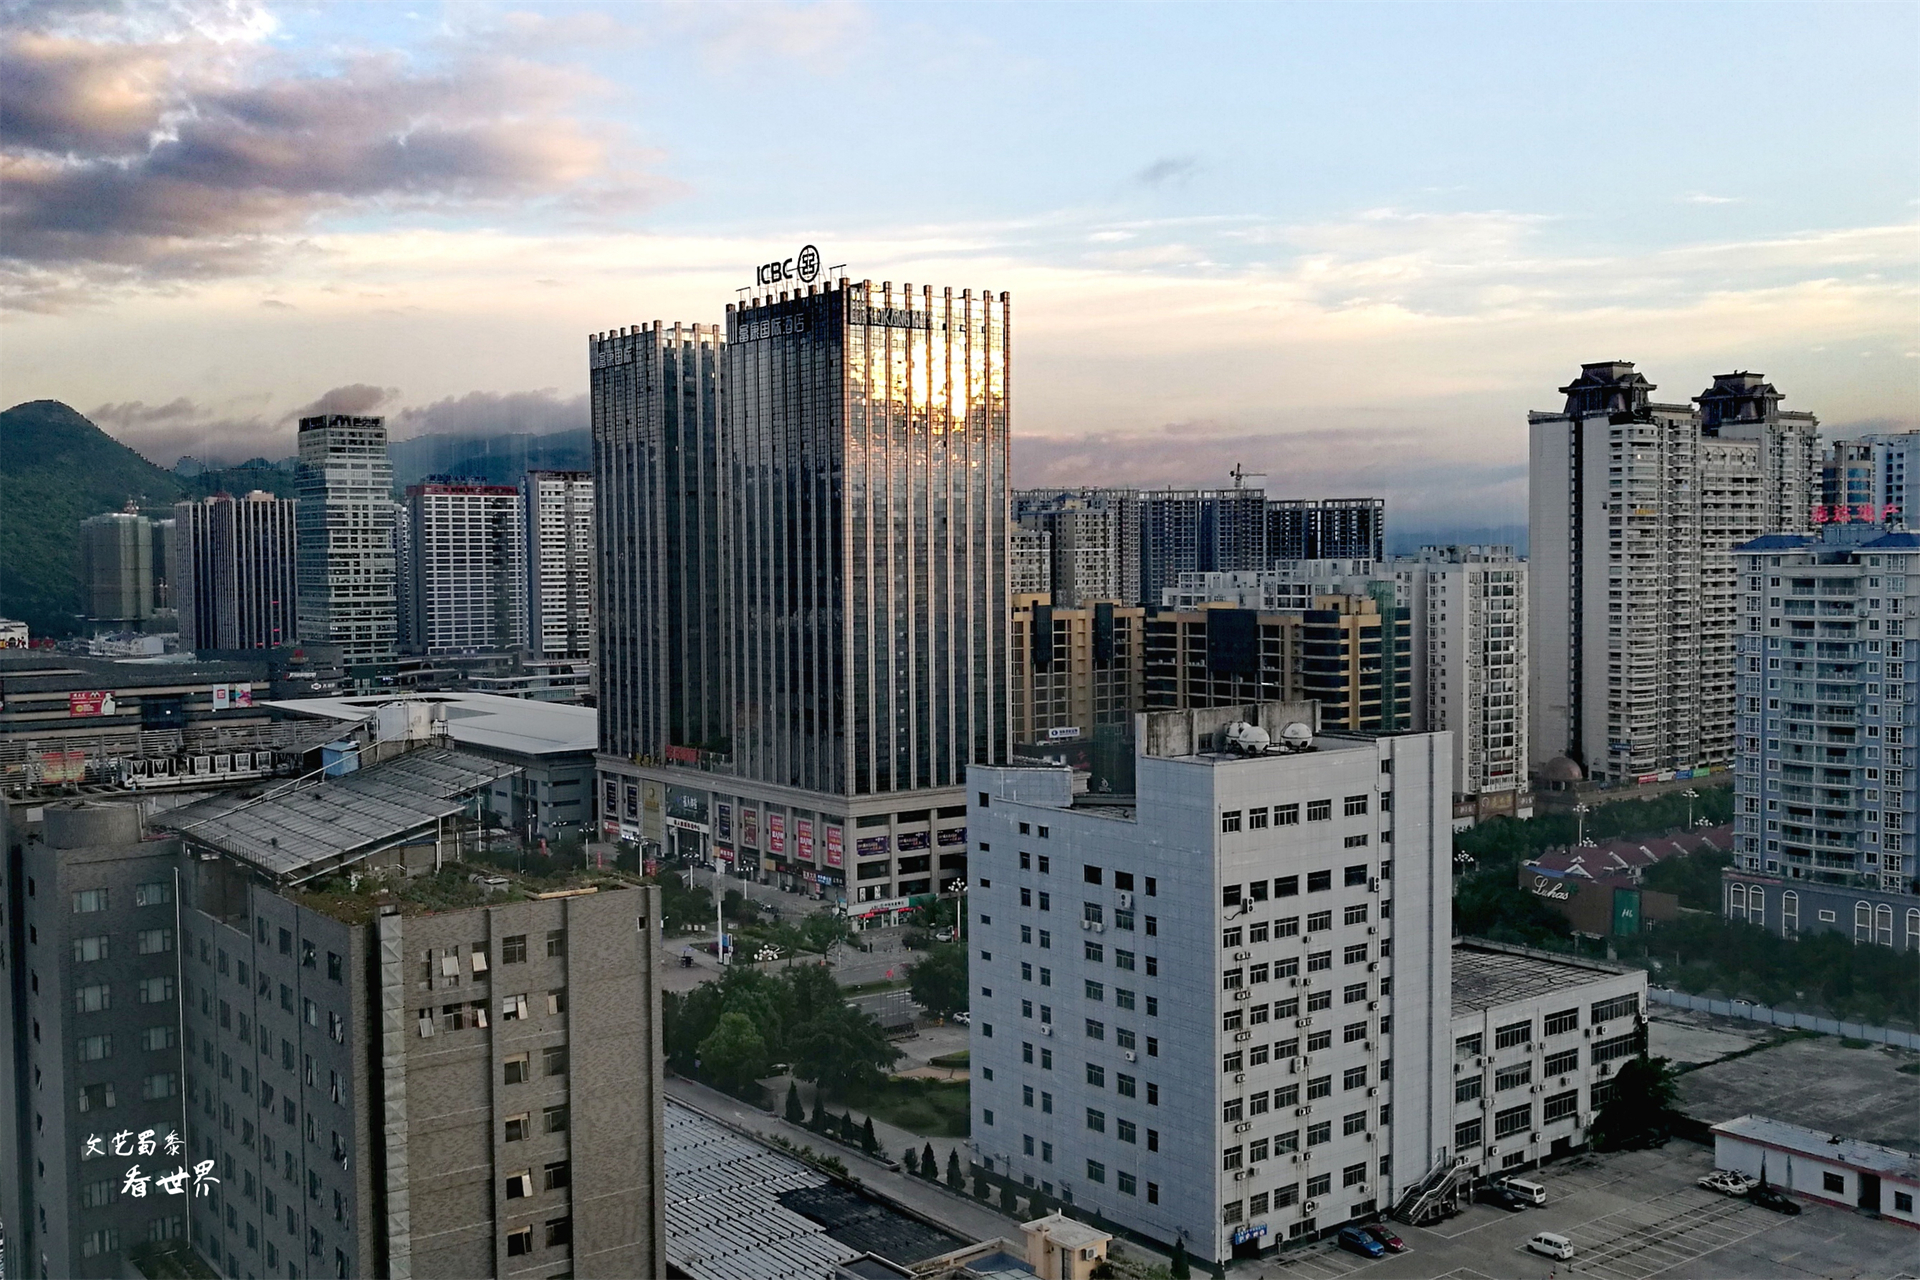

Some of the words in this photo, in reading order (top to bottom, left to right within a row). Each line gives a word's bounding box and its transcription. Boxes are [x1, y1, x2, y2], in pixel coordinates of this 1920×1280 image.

[757, 258, 793, 286] ICBC
[738, 312, 804, 343] 富康国际酒店
